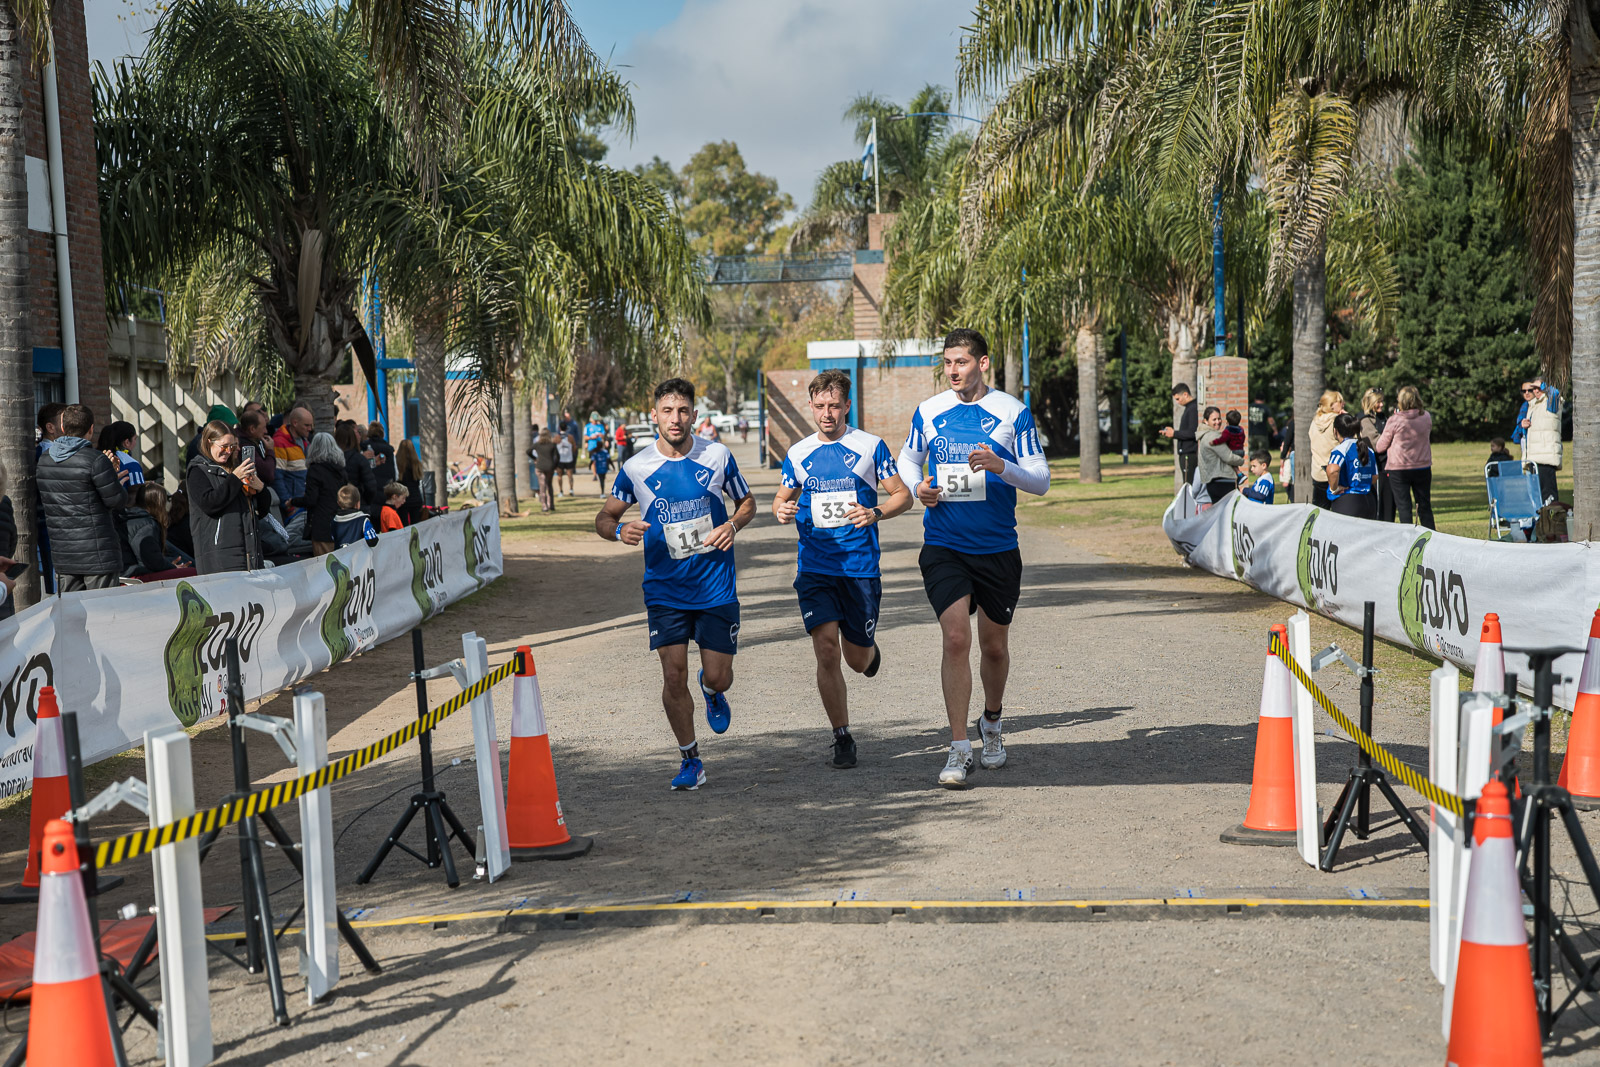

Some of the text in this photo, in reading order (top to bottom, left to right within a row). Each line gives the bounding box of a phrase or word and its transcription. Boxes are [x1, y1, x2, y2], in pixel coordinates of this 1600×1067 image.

[934, 436, 948, 463] 3
[947, 475, 972, 493] 51
[655, 498, 671, 525] 3
[821, 502, 846, 519] 33
[678, 529, 703, 549] 11
